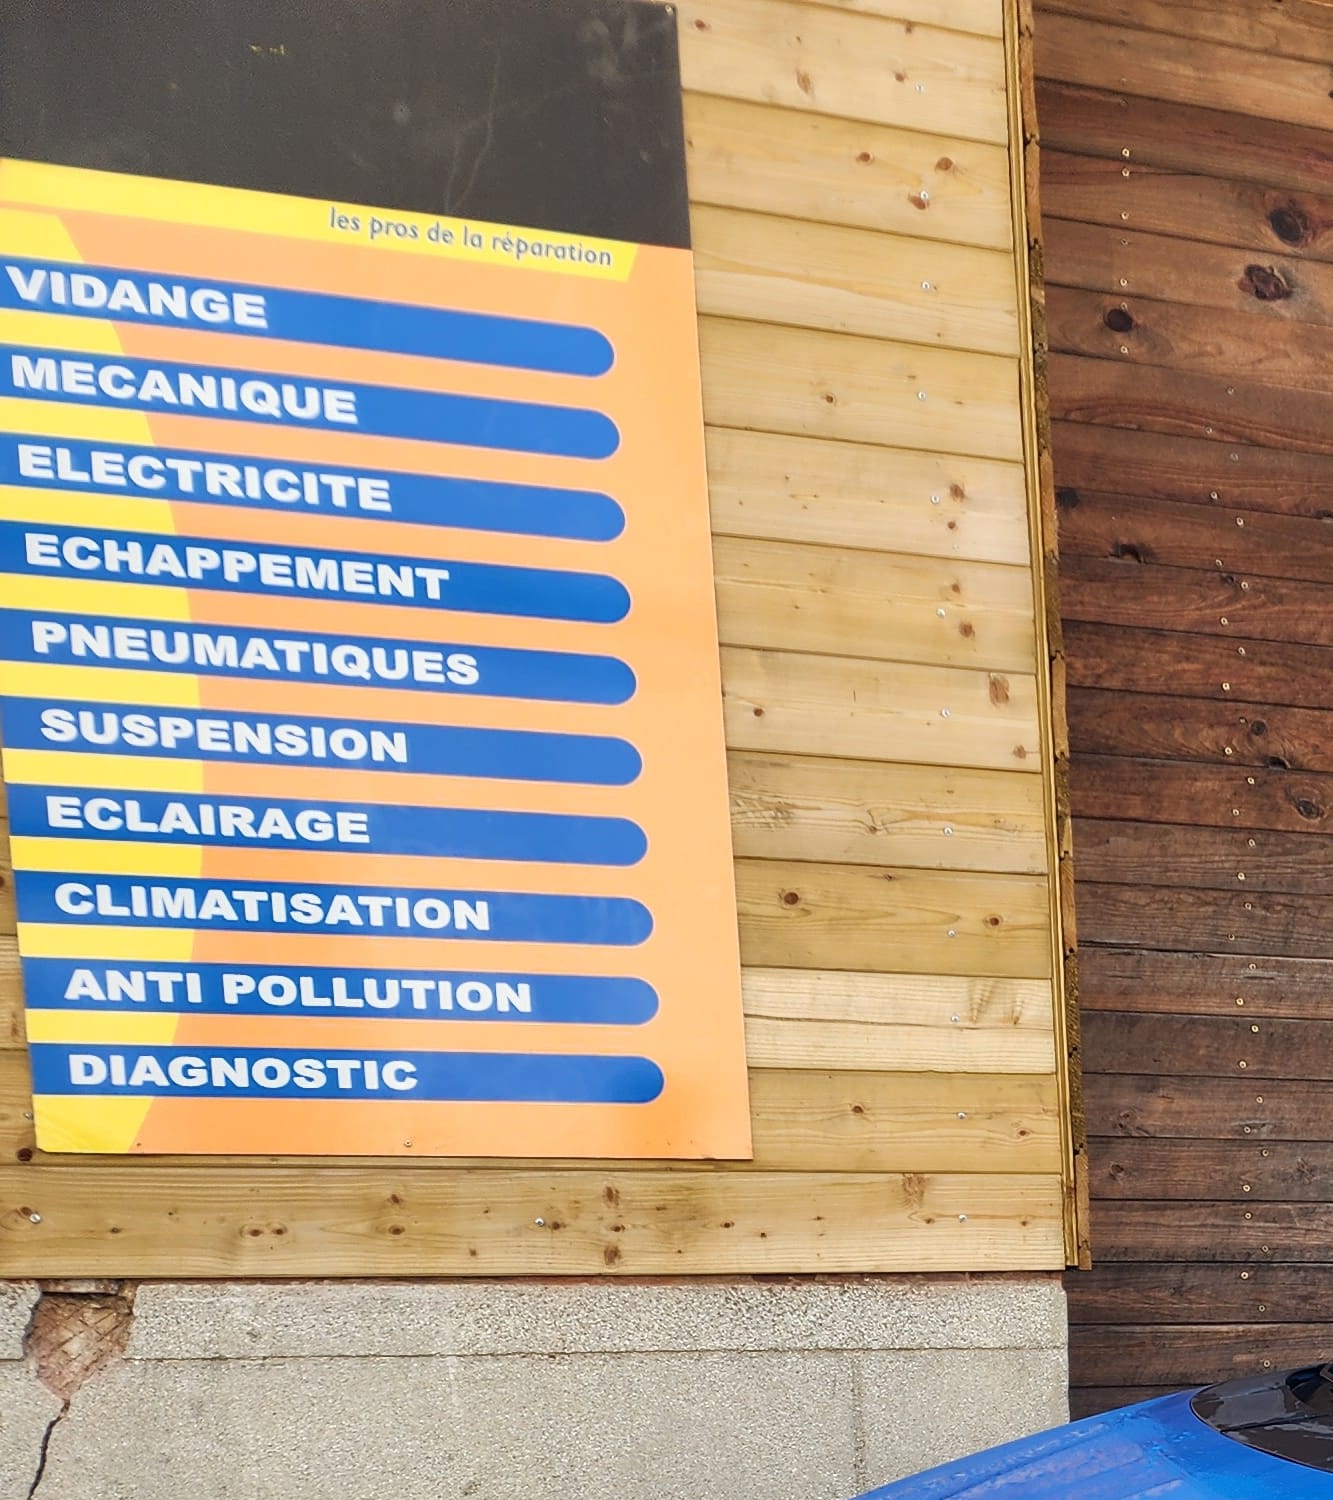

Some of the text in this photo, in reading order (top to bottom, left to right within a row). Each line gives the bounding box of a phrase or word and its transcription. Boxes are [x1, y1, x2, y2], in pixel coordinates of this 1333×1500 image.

[330, 207, 612, 266] les pros de la réparation
[5, 265, 268, 329] VIDANGE
[11, 355, 358, 425] MECANIQUE
[18, 443, 393, 513] ELECTRICITE
[25, 533, 449, 600] ECHAPPEMENT
[31, 620, 480, 686] PNEUMATIQUES
[40, 708, 408, 763] SUSPENSION
[45, 795, 370, 844] ECLAIRAGE
[53, 881, 490, 932] CLIMATISATION
[64, 969, 532, 1014] ANTI POLLUTION
[69, 1054, 418, 1092] DIAGNOSTIC
